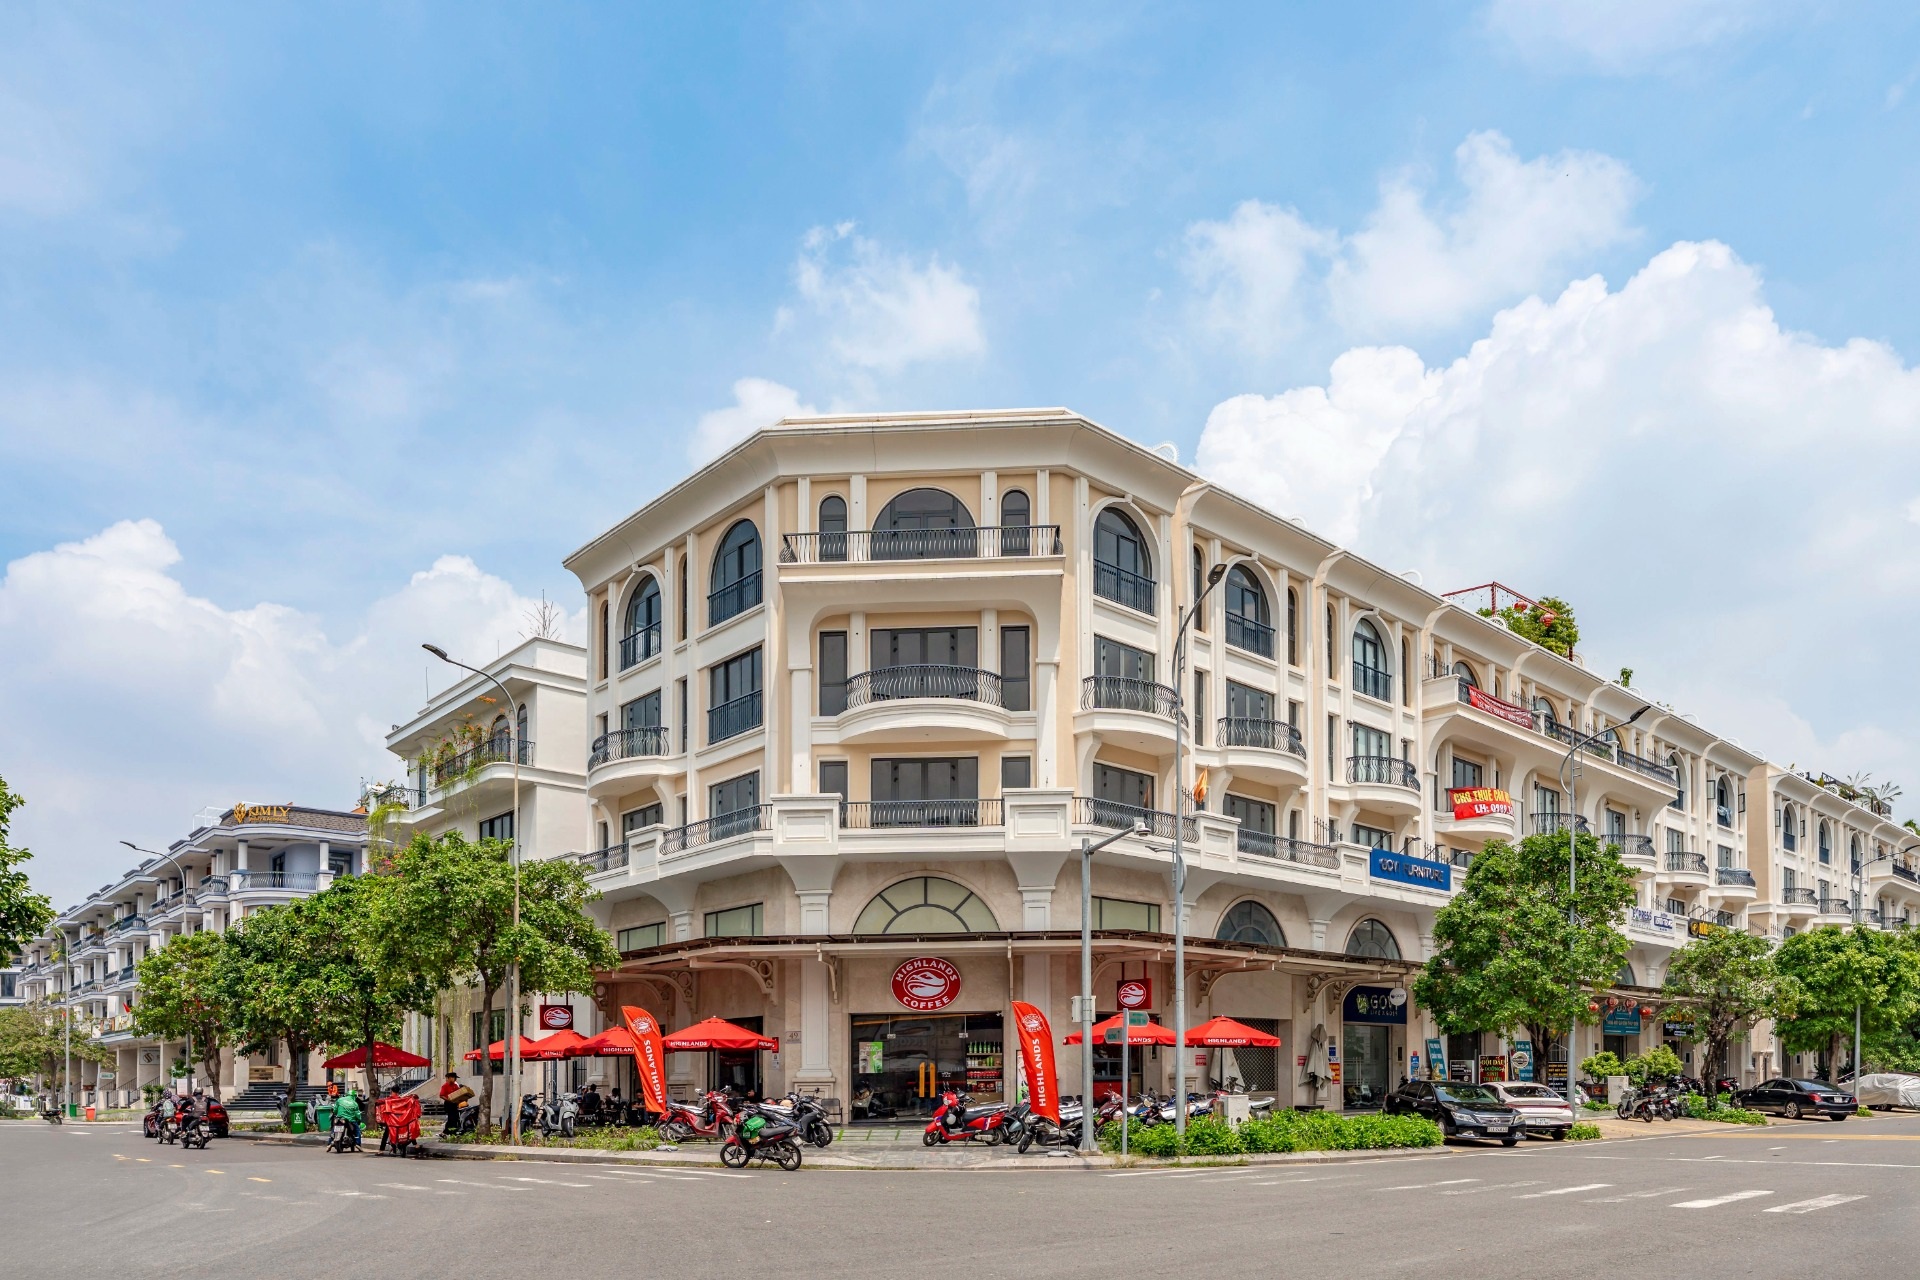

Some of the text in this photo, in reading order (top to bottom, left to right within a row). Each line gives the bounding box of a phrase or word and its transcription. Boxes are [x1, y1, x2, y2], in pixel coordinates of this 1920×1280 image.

[1474, 803, 1489, 814] LH:
[895, 960, 958, 982] HIGHLANDS
[902, 995, 950, 1009] COFFEE
[643, 1039, 664, 1104] HIGHLANDS
[1032, 1038, 1046, 1107] HIGHLANDS
